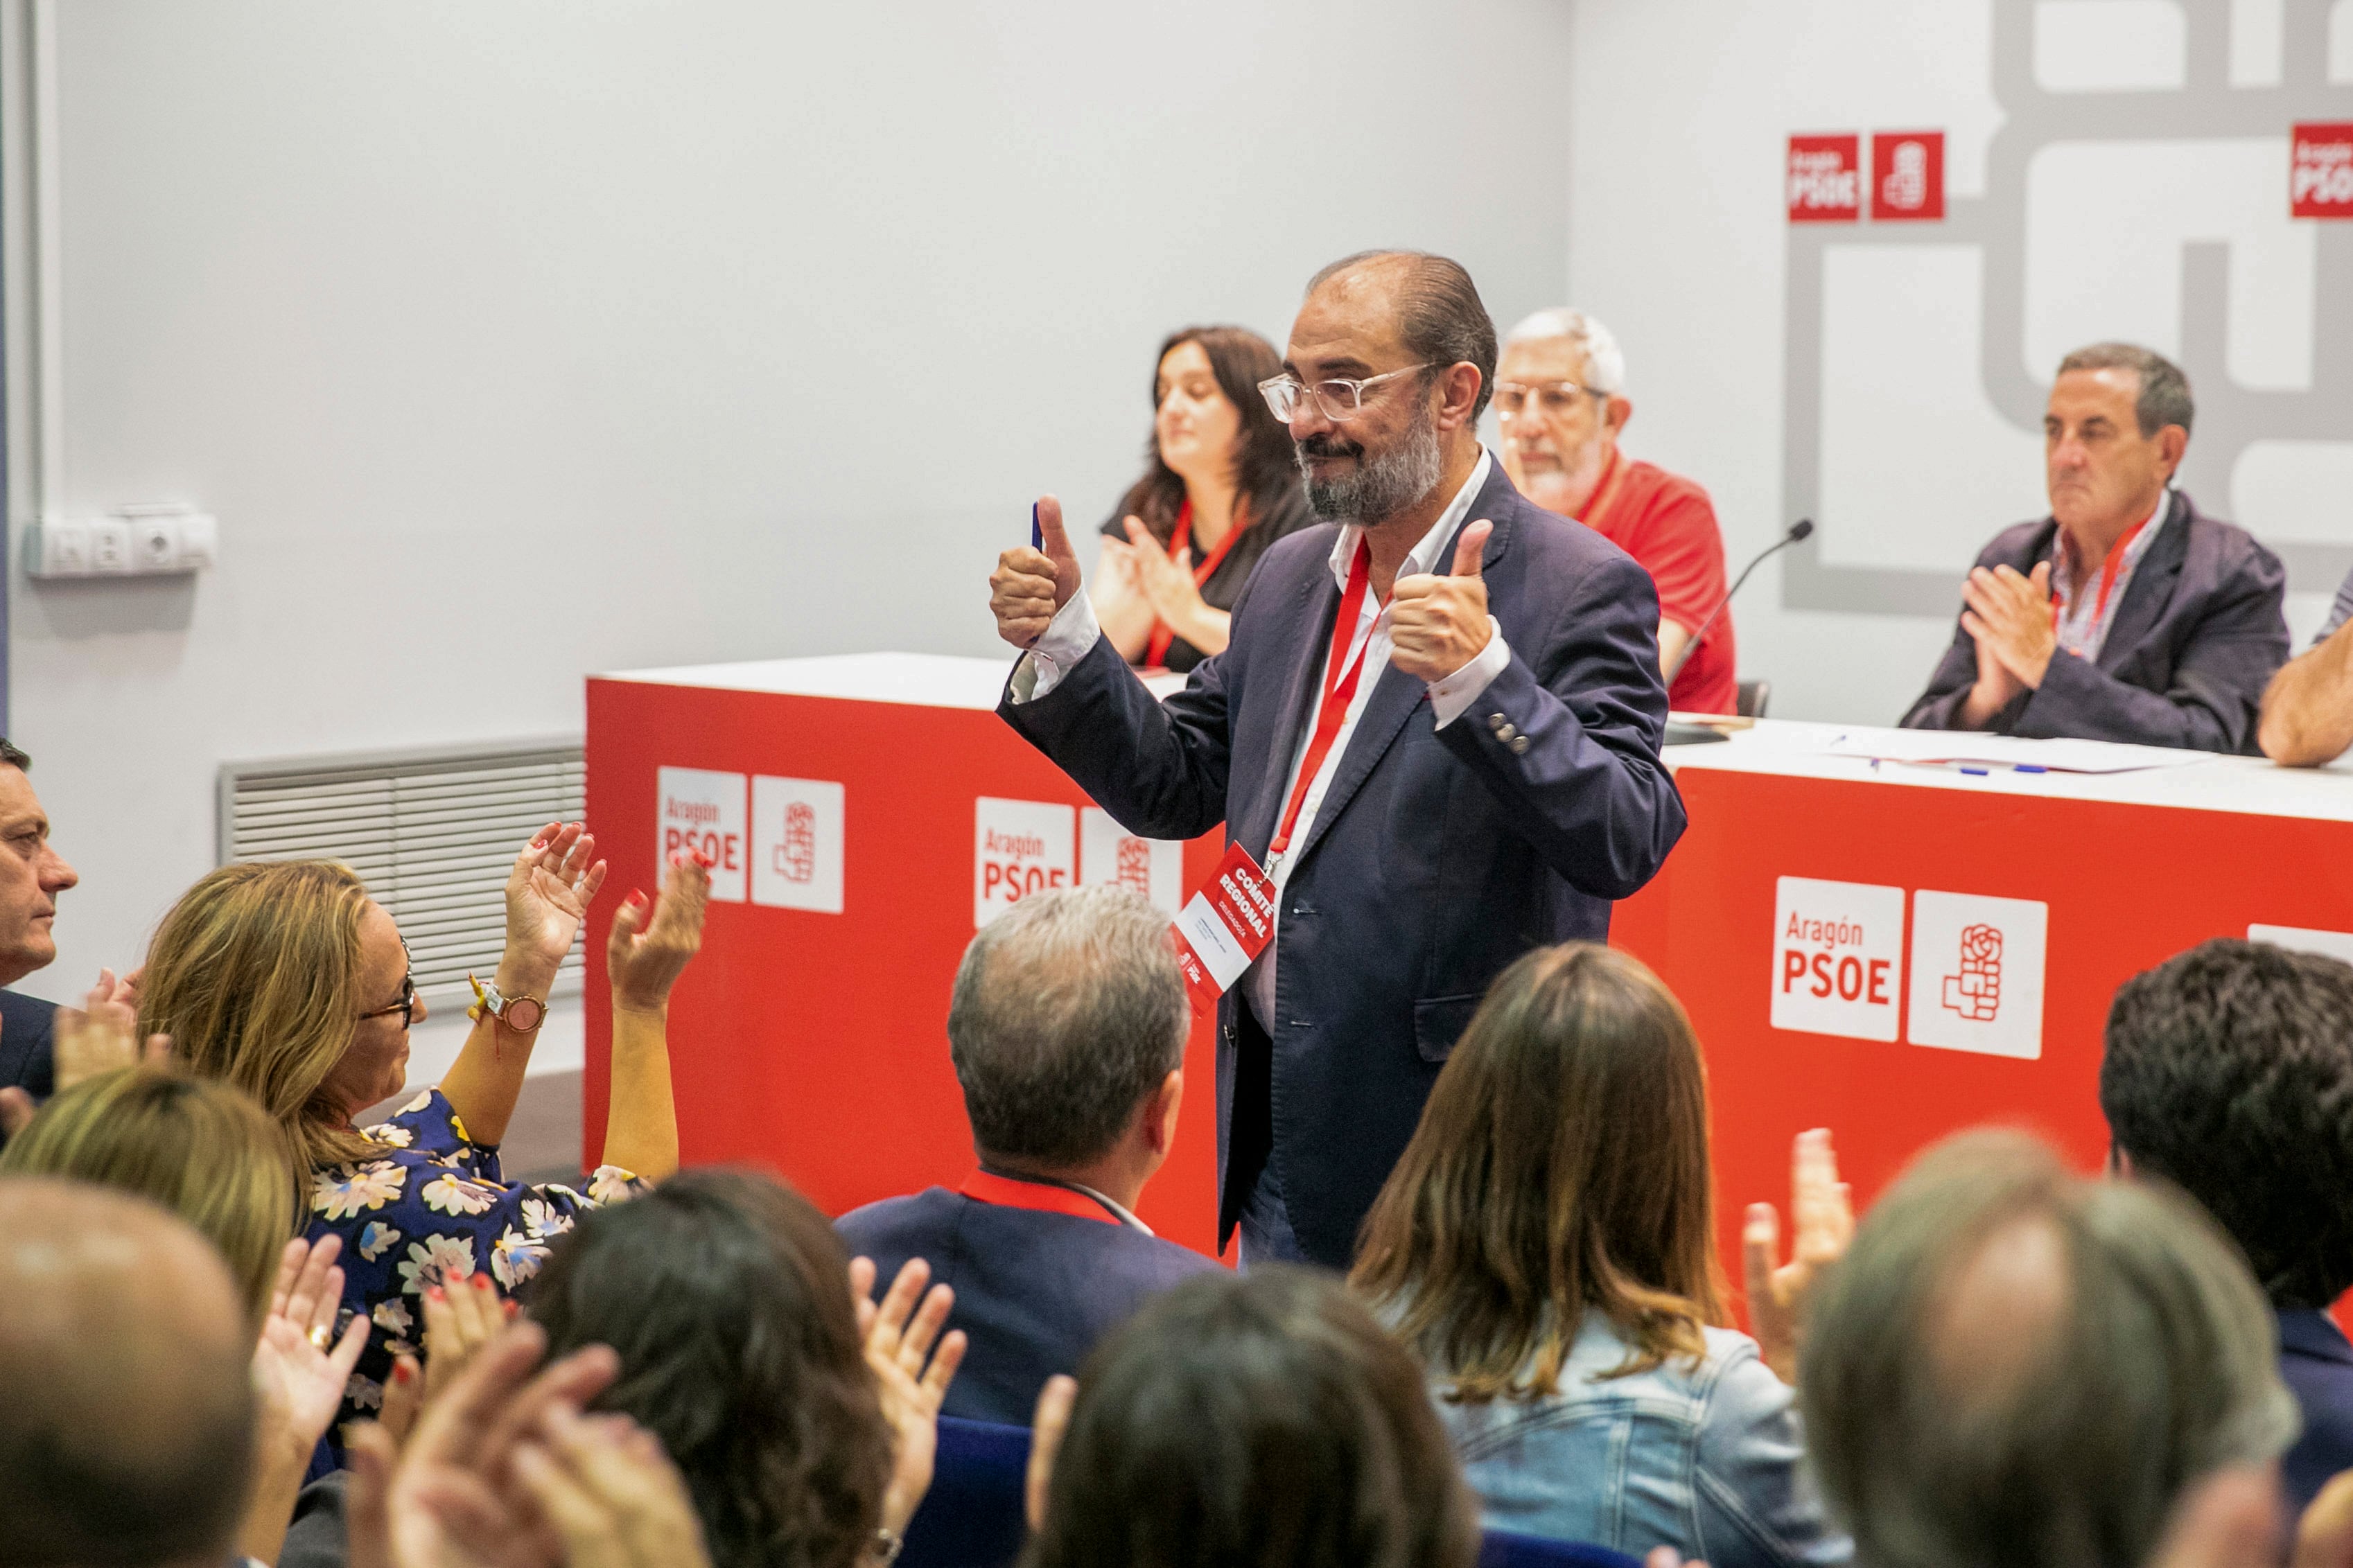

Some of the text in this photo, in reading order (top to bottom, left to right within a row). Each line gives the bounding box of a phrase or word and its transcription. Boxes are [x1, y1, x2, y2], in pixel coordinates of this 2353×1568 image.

[1788, 171, 1856, 208] PSOE
[2294, 165, 2353, 203] PSO
[665, 796, 719, 826] Aragón
[984, 827, 1044, 860] Aragón
[1220, 873, 1267, 938] REGIONAL
[1235, 867, 1275, 919] COMITÉ
[1785, 910, 1864, 950] Aragón
[1783, 949, 1891, 1005] PSOE
